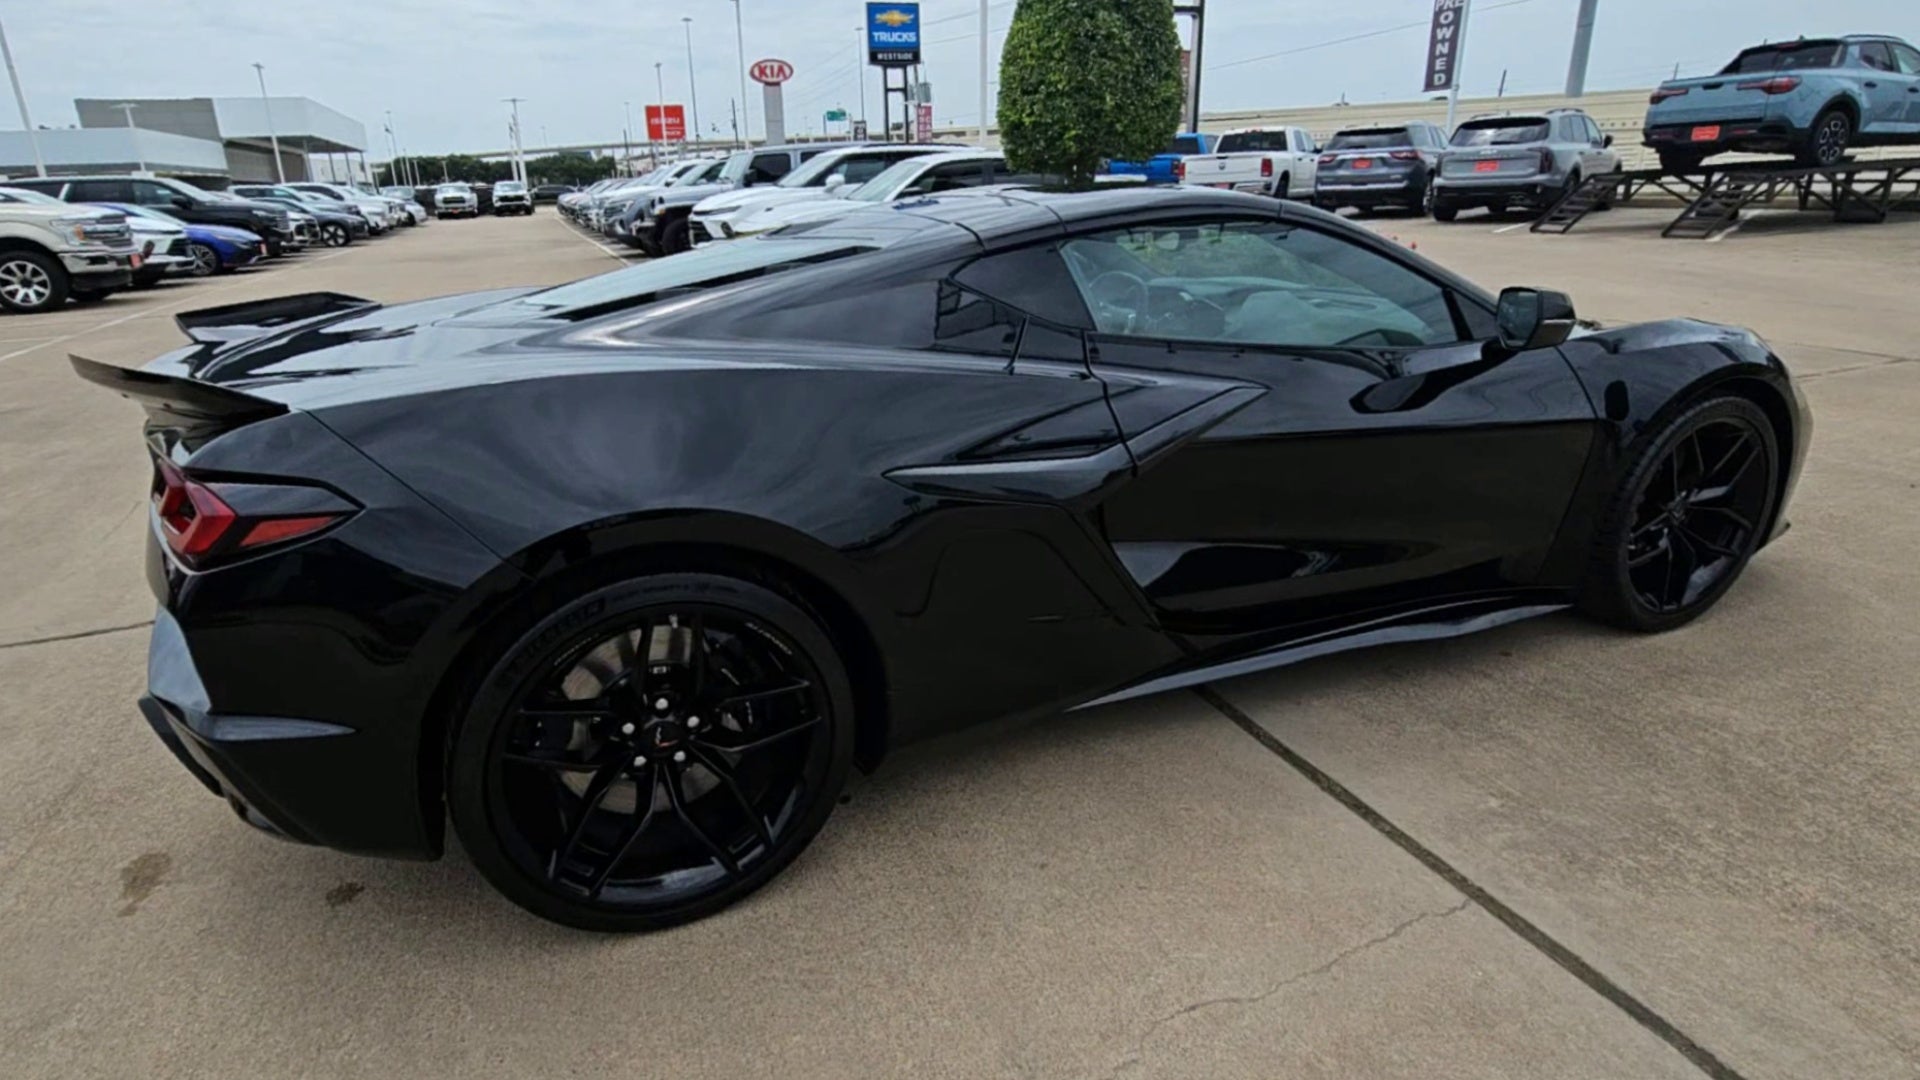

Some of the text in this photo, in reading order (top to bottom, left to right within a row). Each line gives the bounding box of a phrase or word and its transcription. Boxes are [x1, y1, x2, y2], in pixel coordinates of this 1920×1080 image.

[872, 31, 917, 43] TRUCKS
[1433, 10, 1455, 86] OWNED
[758, 64, 787, 79] KIA
[650, 117, 680, 125] ISZU
